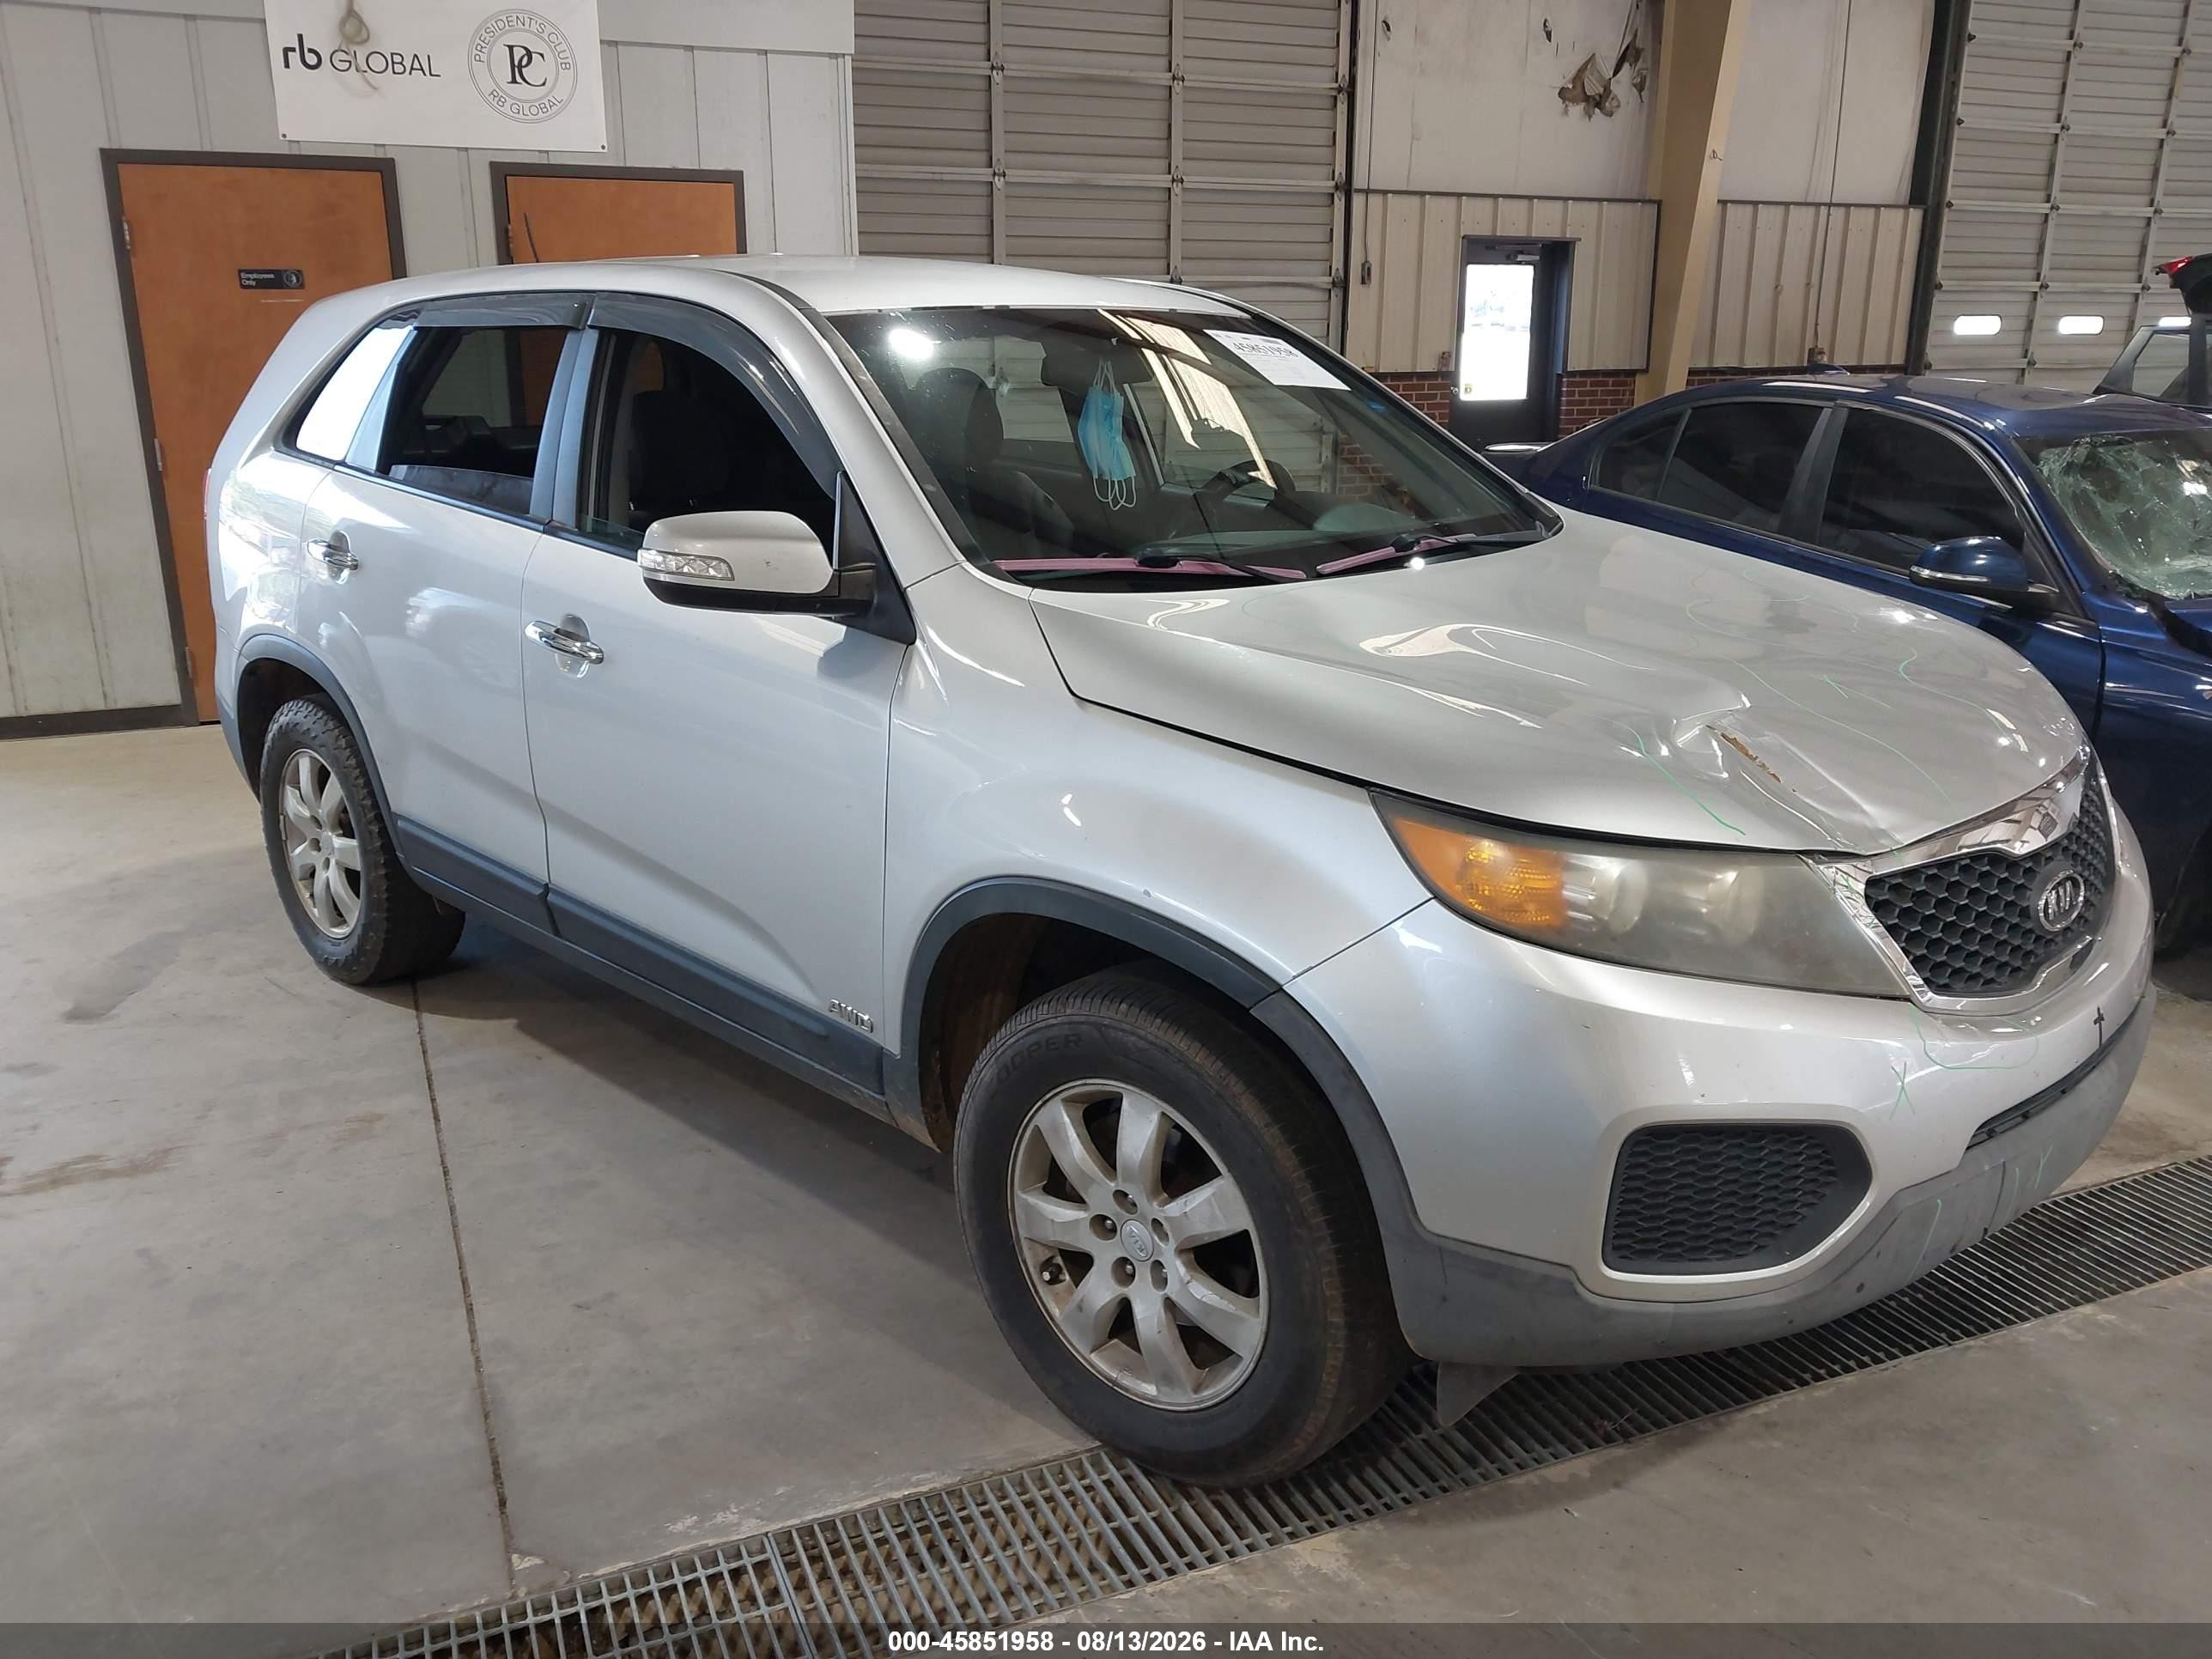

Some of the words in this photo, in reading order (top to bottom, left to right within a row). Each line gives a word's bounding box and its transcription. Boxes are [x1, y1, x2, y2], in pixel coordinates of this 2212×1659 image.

[283, 33, 322, 70] rb
[330, 50, 441, 77] GLOBAL
[474, 15, 545, 64] PRESIDENT'S
[547, 32, 571, 71] CLUB
[502, 44, 548, 87] PC
[489, 88, 507, 107] RB
[509, 95, 563, 116] GLOBAL
[990, 1033, 1082, 1092] OOPER
